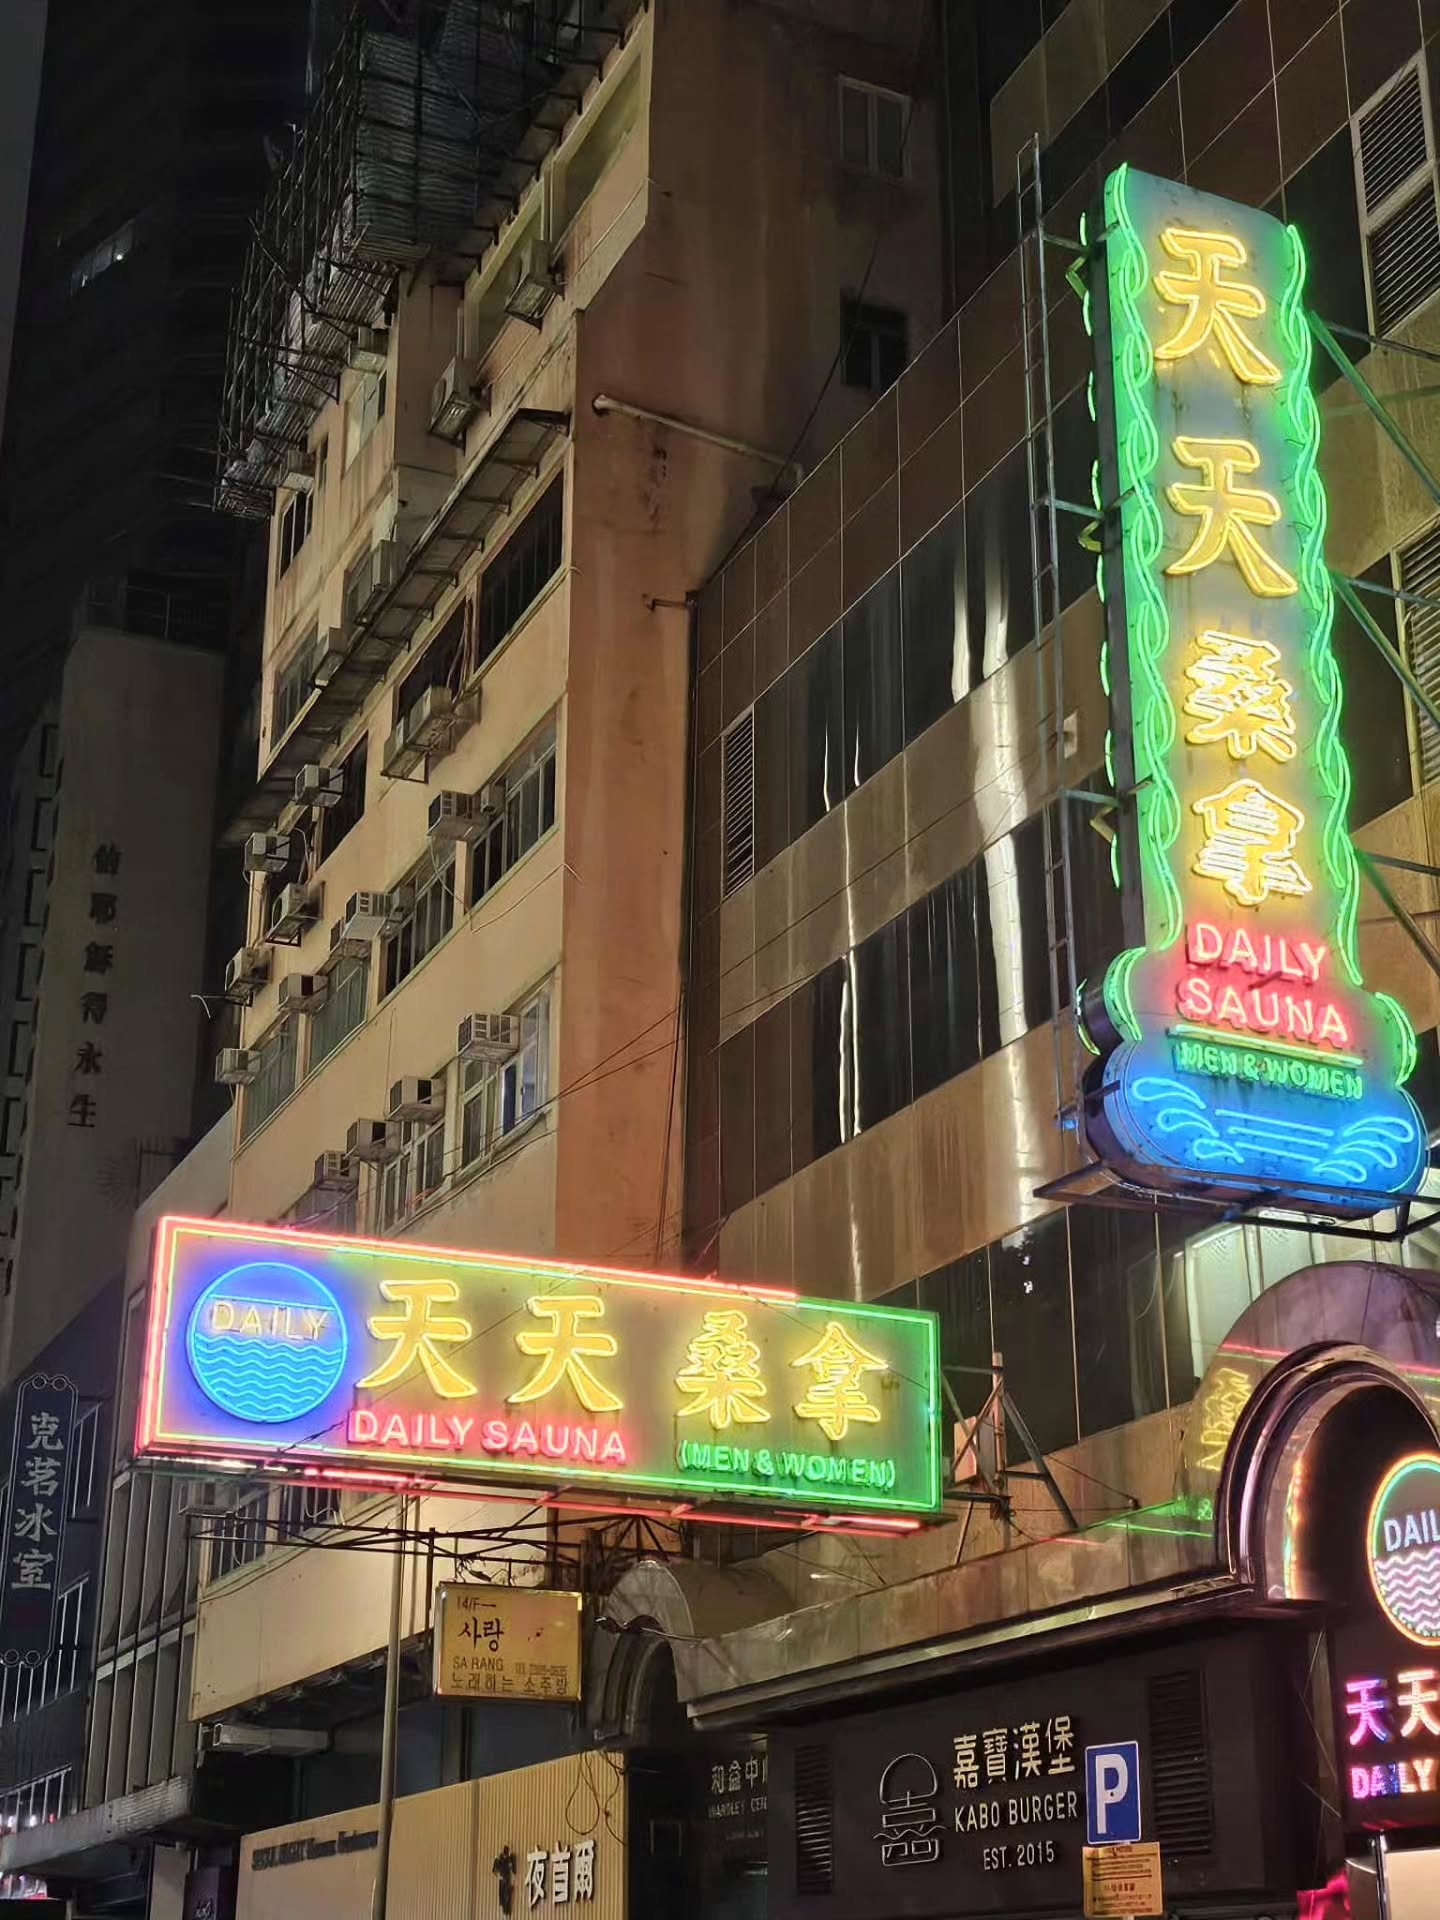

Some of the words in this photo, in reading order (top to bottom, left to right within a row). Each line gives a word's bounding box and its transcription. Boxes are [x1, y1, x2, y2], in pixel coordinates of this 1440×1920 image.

[1154, 227, 1313, 904] 天天桑拿
[1190, 922, 1328, 983] DAILY
[1184, 977, 1349, 1046] SAUNA
[1176, 1041, 1238, 1075] MEN
[1243, 1053, 1260, 1081] &
[1263, 1056, 1363, 1100] WOMEN
[210, 1302, 330, 1342] DAILY
[355, 1279, 889, 1440] 天天桑拿
[349, 1409, 475, 1448] DAILY
[481, 1420, 628, 1463] SAUNA
[756, 1448, 775, 1477] &
[11, 1411, 65, 1590] 克茗冰室
[457, 1616, 505, 1652] 사랑
[952, 1715, 1075, 1789] 嘉寶漢堡
[1351, 1758, 1434, 1799] DAILY
[954, 1800, 1000, 1833] KABO
[1008, 1790, 1079, 1826] BURGER
[1095, 1753, 1129, 1835] P
[525, 1839, 594, 1909] 夜首爾
[983, 1845, 1012, 1871] EST.
[1016, 1840, 1055, 1866] 2015
